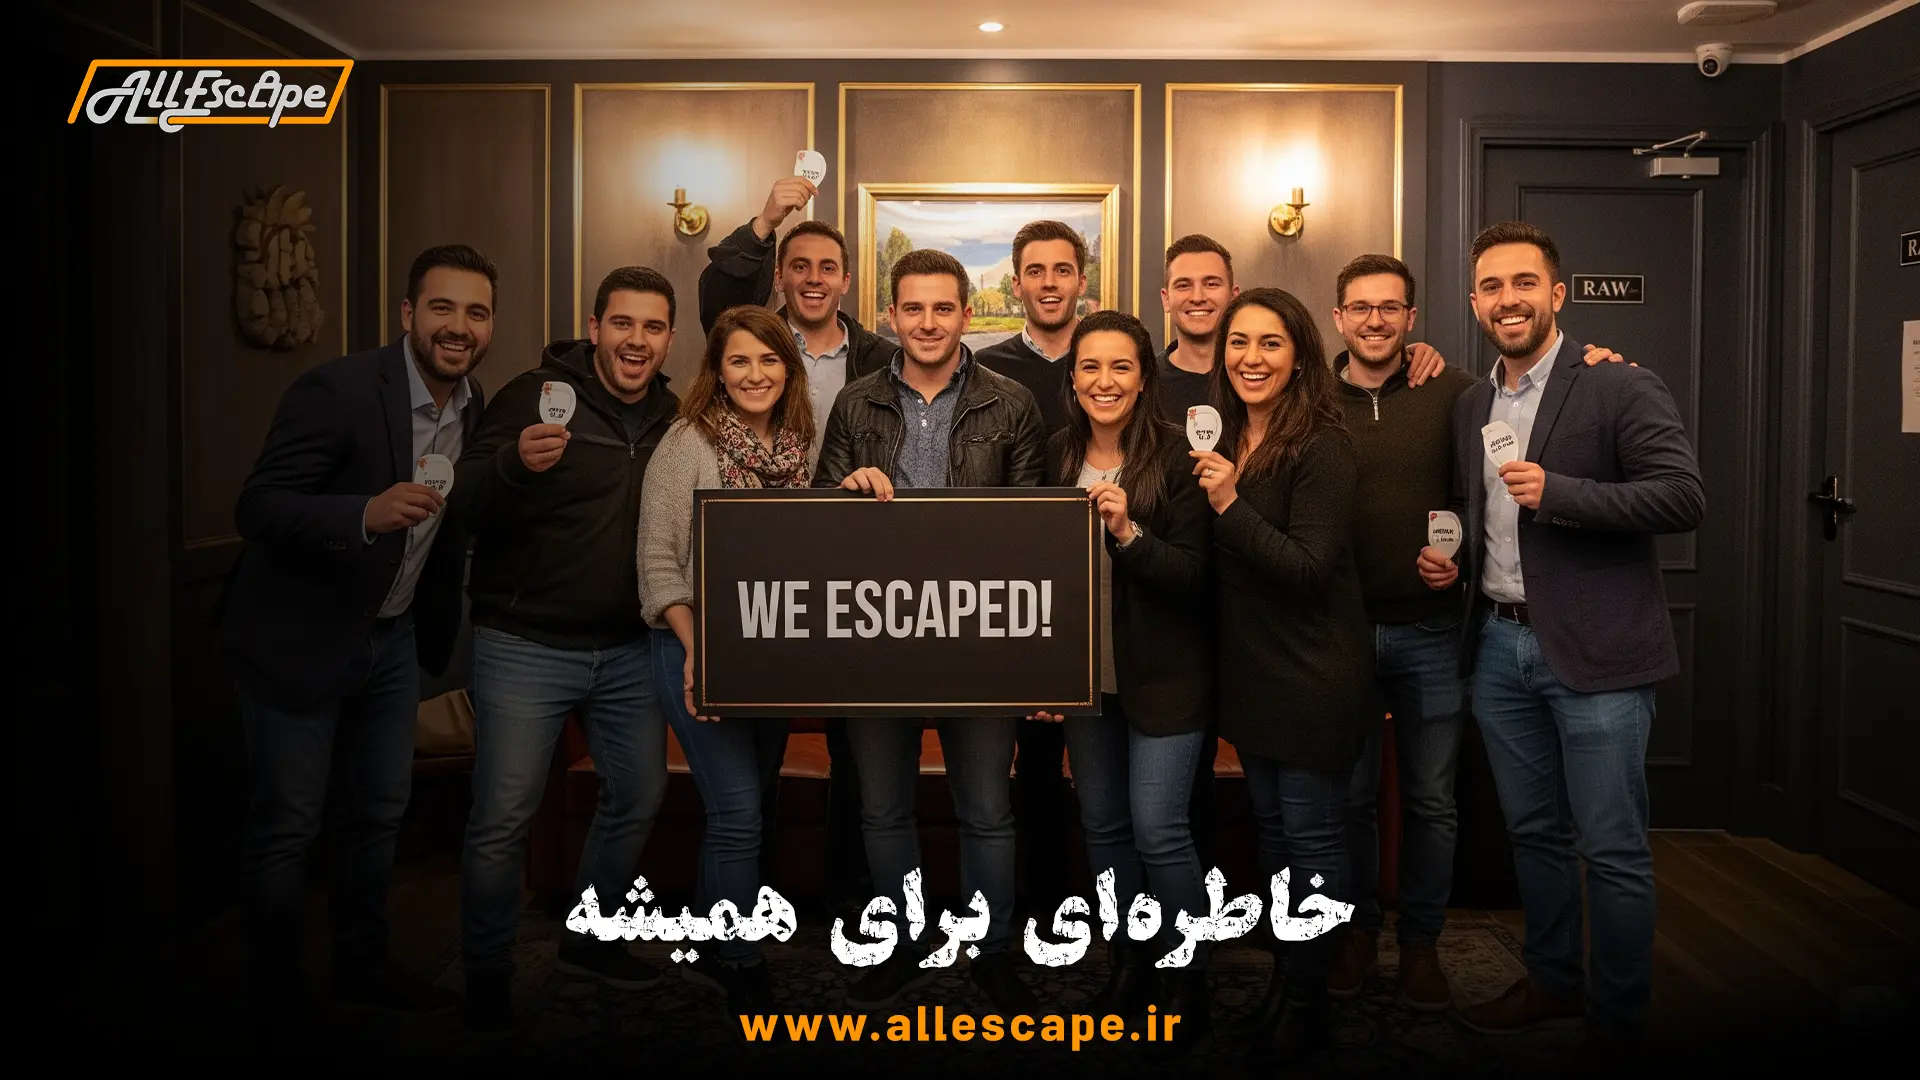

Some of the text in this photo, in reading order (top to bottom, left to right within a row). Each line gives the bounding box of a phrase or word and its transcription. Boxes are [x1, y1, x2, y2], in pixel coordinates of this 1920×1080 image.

[1908, 239, 1920, 256] R
[1583, 280, 1630, 297] RAW
[738, 580, 1052, 638] WE ESCAPED!
